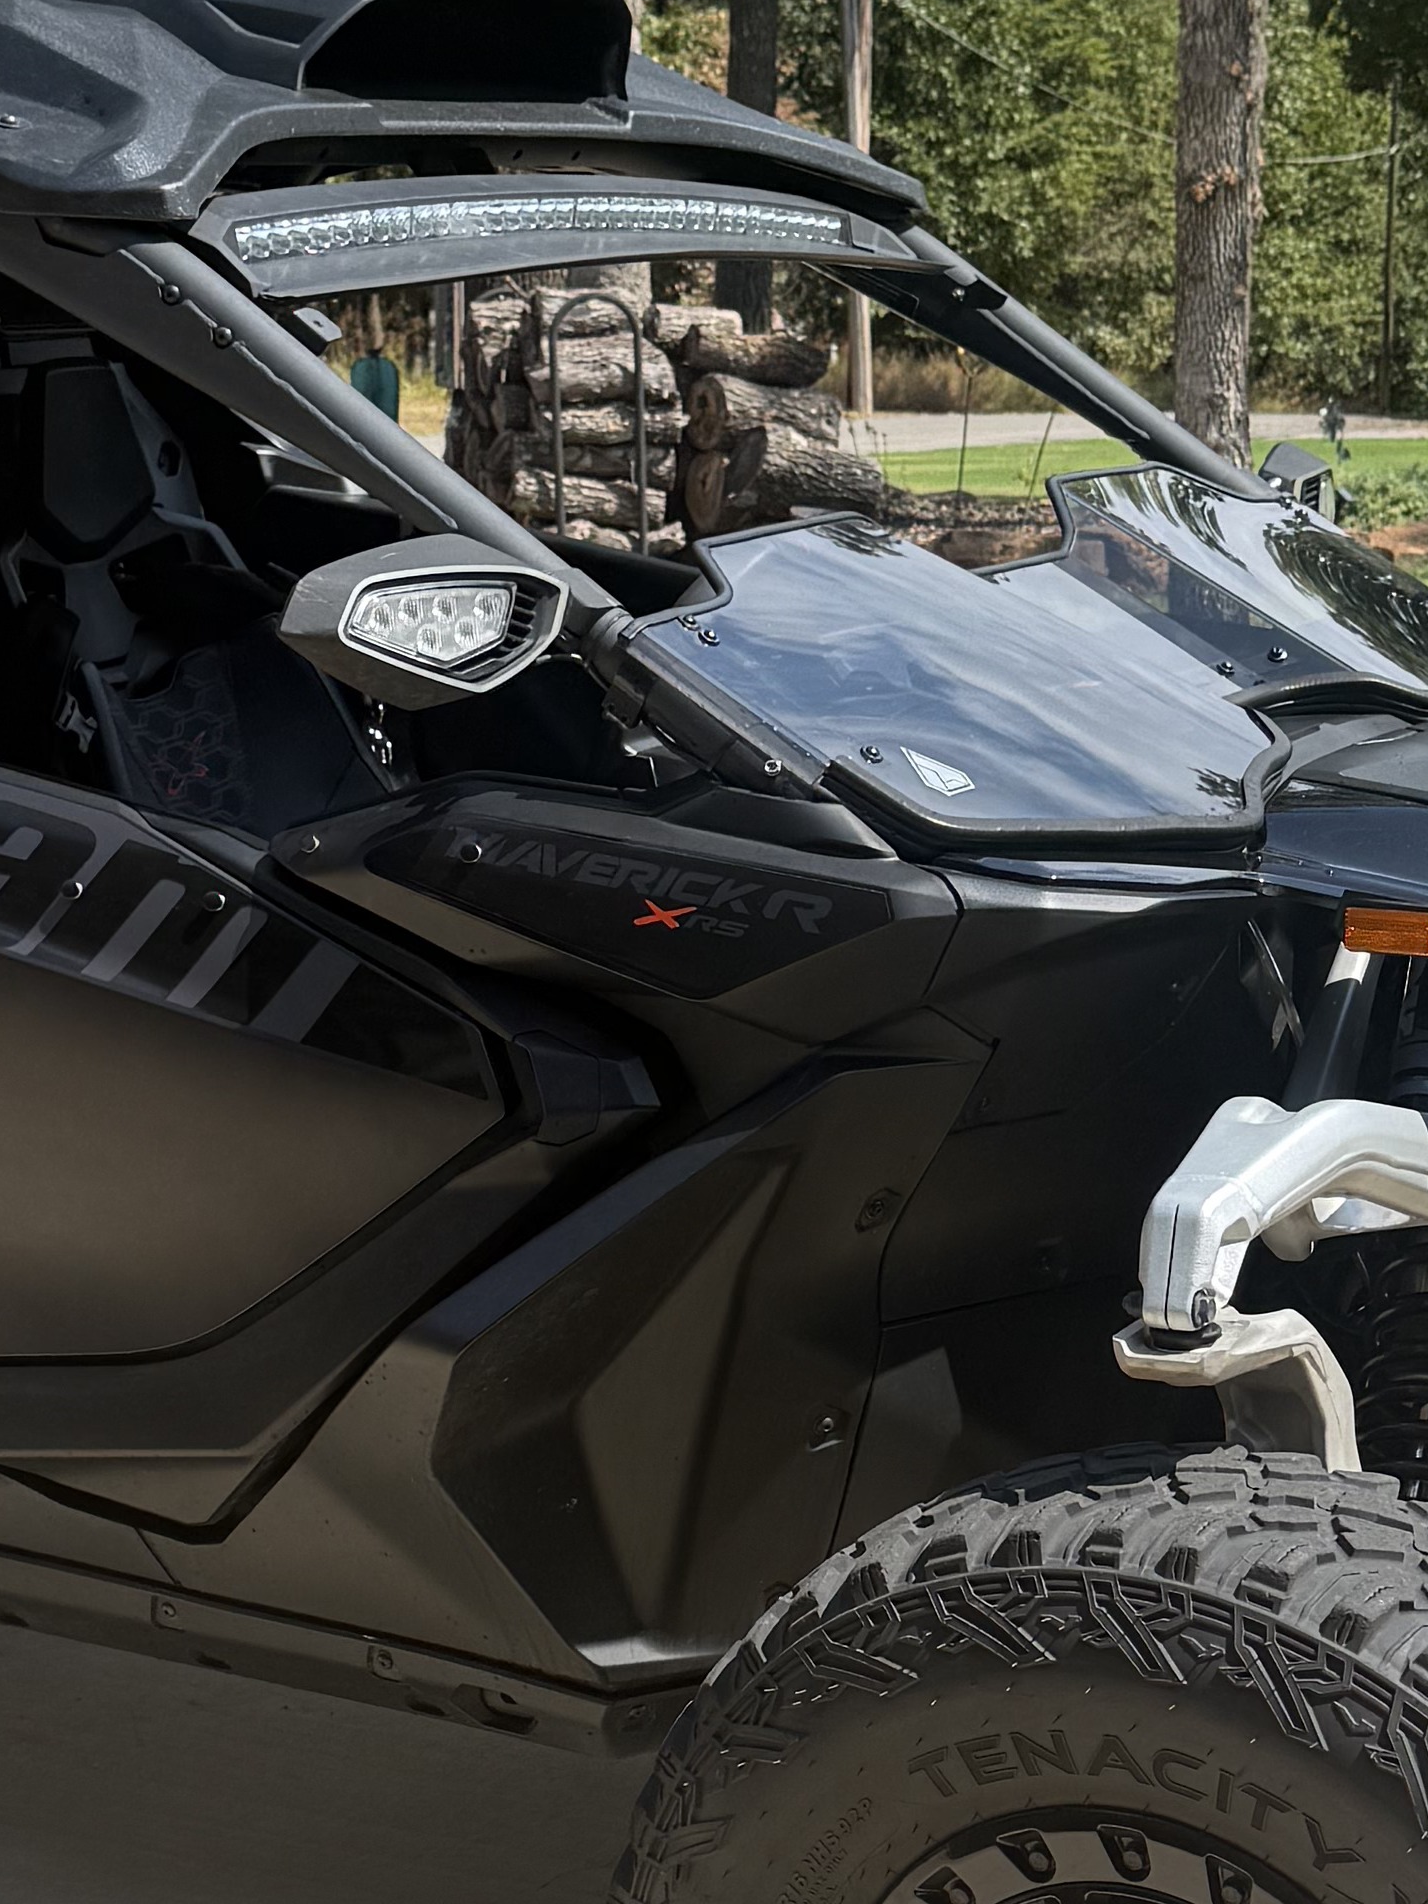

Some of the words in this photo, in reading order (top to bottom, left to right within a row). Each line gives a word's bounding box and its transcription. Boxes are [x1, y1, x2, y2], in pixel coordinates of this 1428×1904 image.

[444, 826, 765, 914] MAVERICK
[762, 889, 834, 936] R
[684, 913, 751, 939] RS
[907, 1729, 1367, 1872] TENACITY
